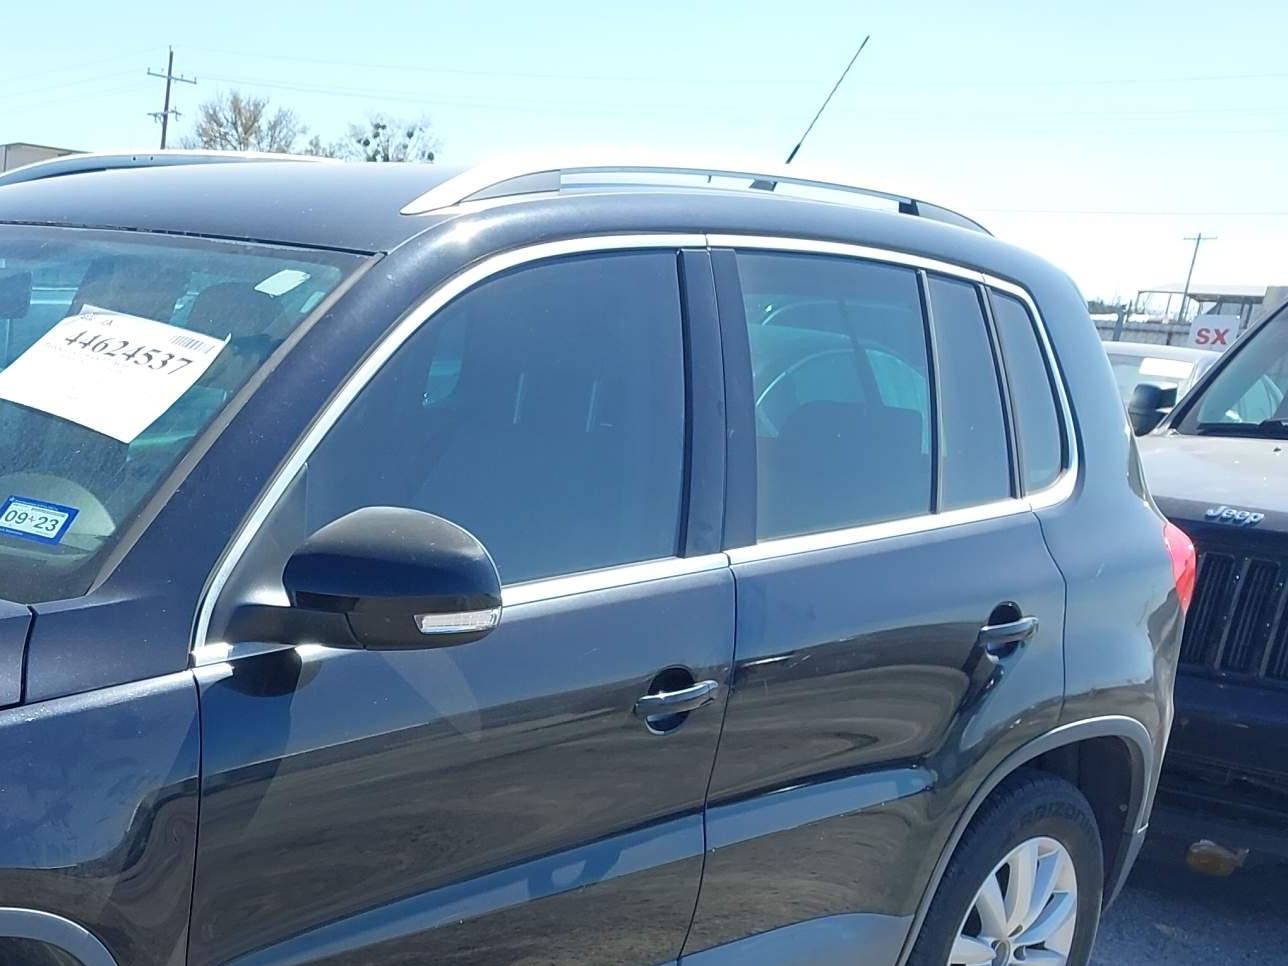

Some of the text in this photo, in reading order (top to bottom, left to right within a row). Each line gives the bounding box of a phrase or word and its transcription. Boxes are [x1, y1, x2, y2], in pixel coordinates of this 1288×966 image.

[1195, 327, 1230, 345] SX
[64, 330, 193, 375] 44624537
[4, 509, 29, 525] 09
[33, 516, 59, 532] 23
[1206, 505, 1265, 527] Jeep
